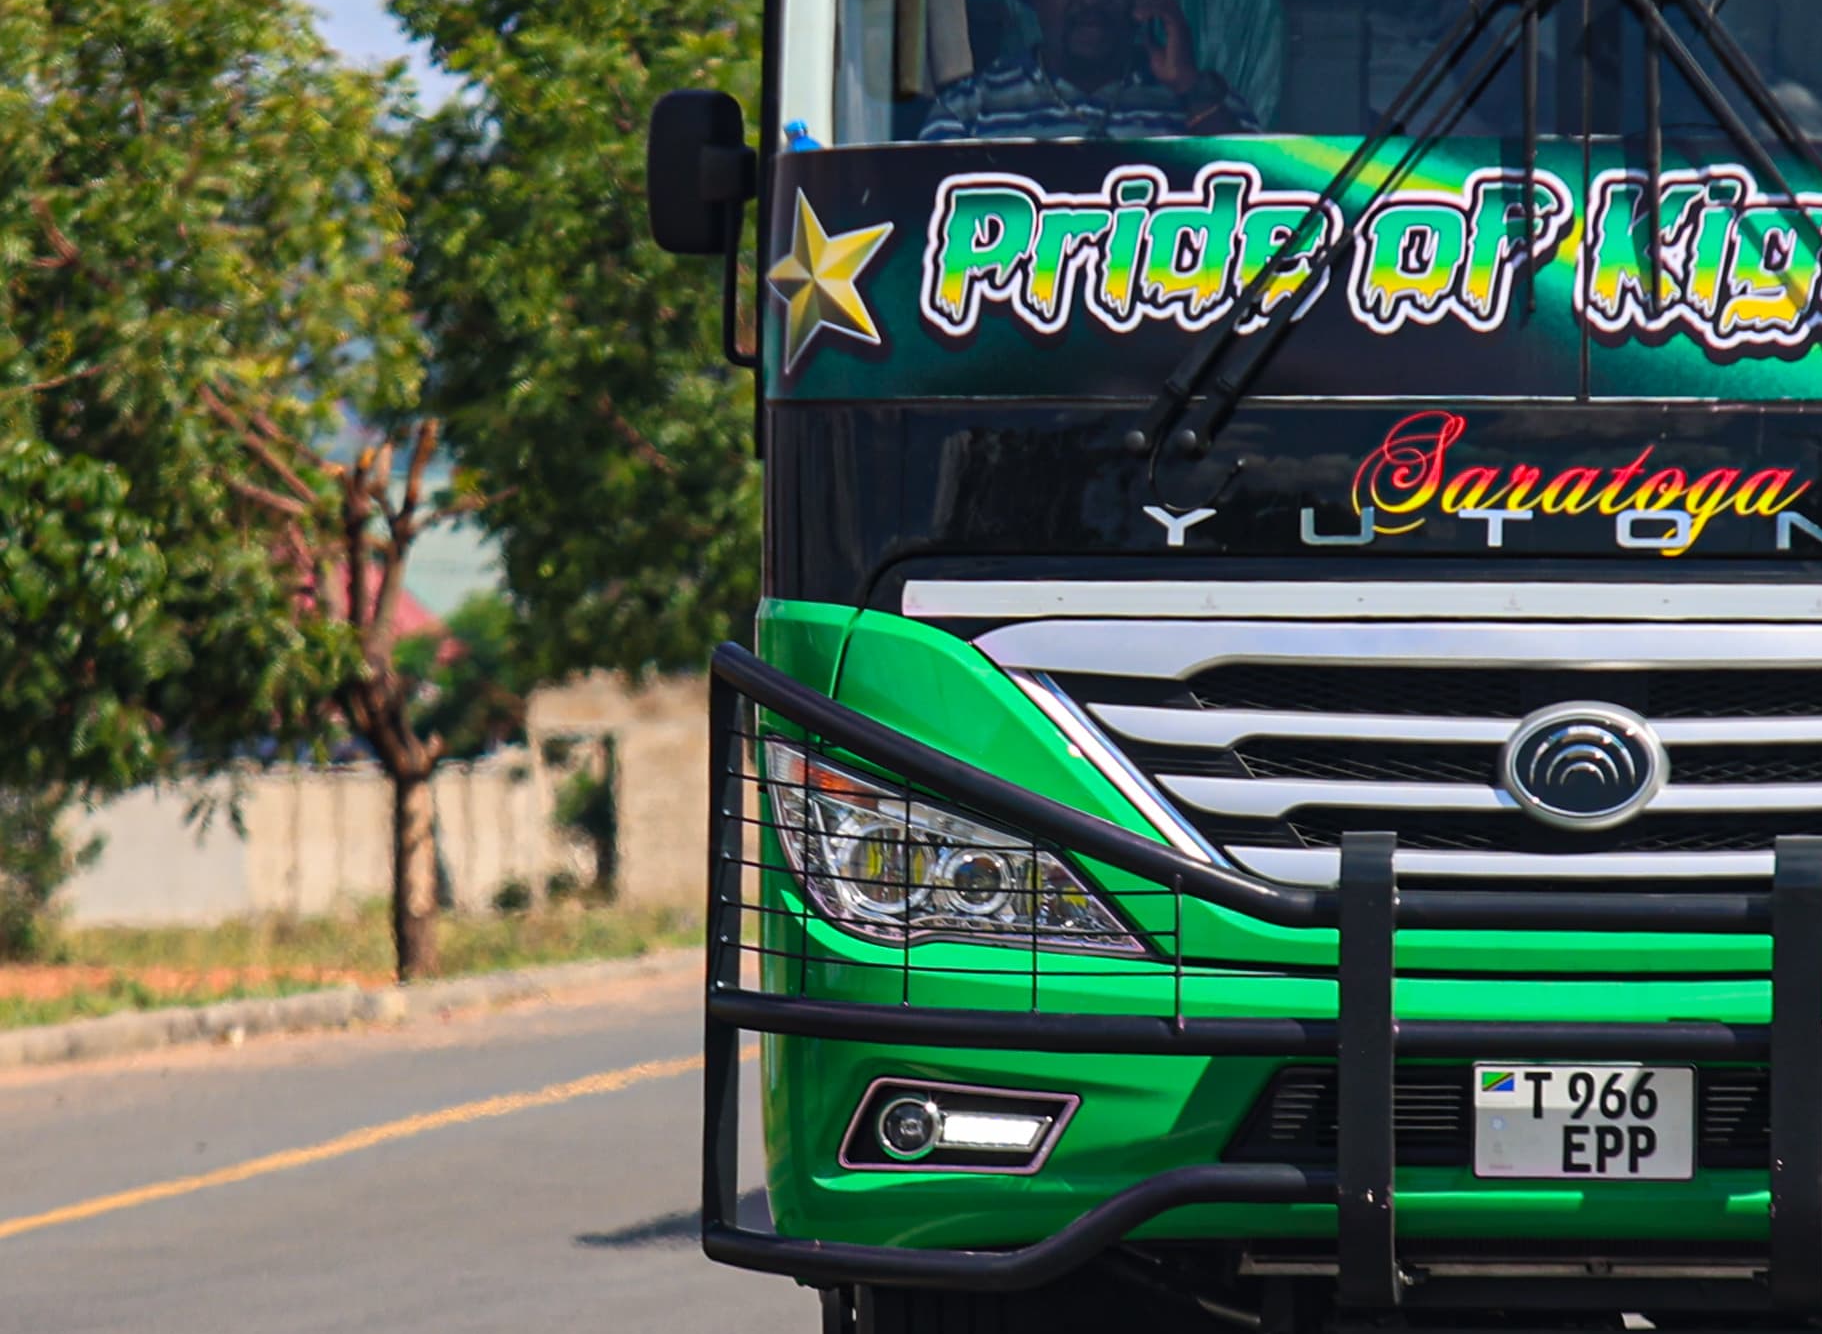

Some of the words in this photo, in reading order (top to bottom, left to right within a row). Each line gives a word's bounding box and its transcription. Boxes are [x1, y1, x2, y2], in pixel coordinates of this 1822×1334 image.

[922, 161, 1345, 337] Pride
[1348, 165, 1577, 334] of
[1352, 410, 1813, 557] Saratoga
[1524, 1071, 1552, 1119] T
[1568, 1071, 1658, 1120] 966
[1562, 1125, 1657, 1173] EPP
